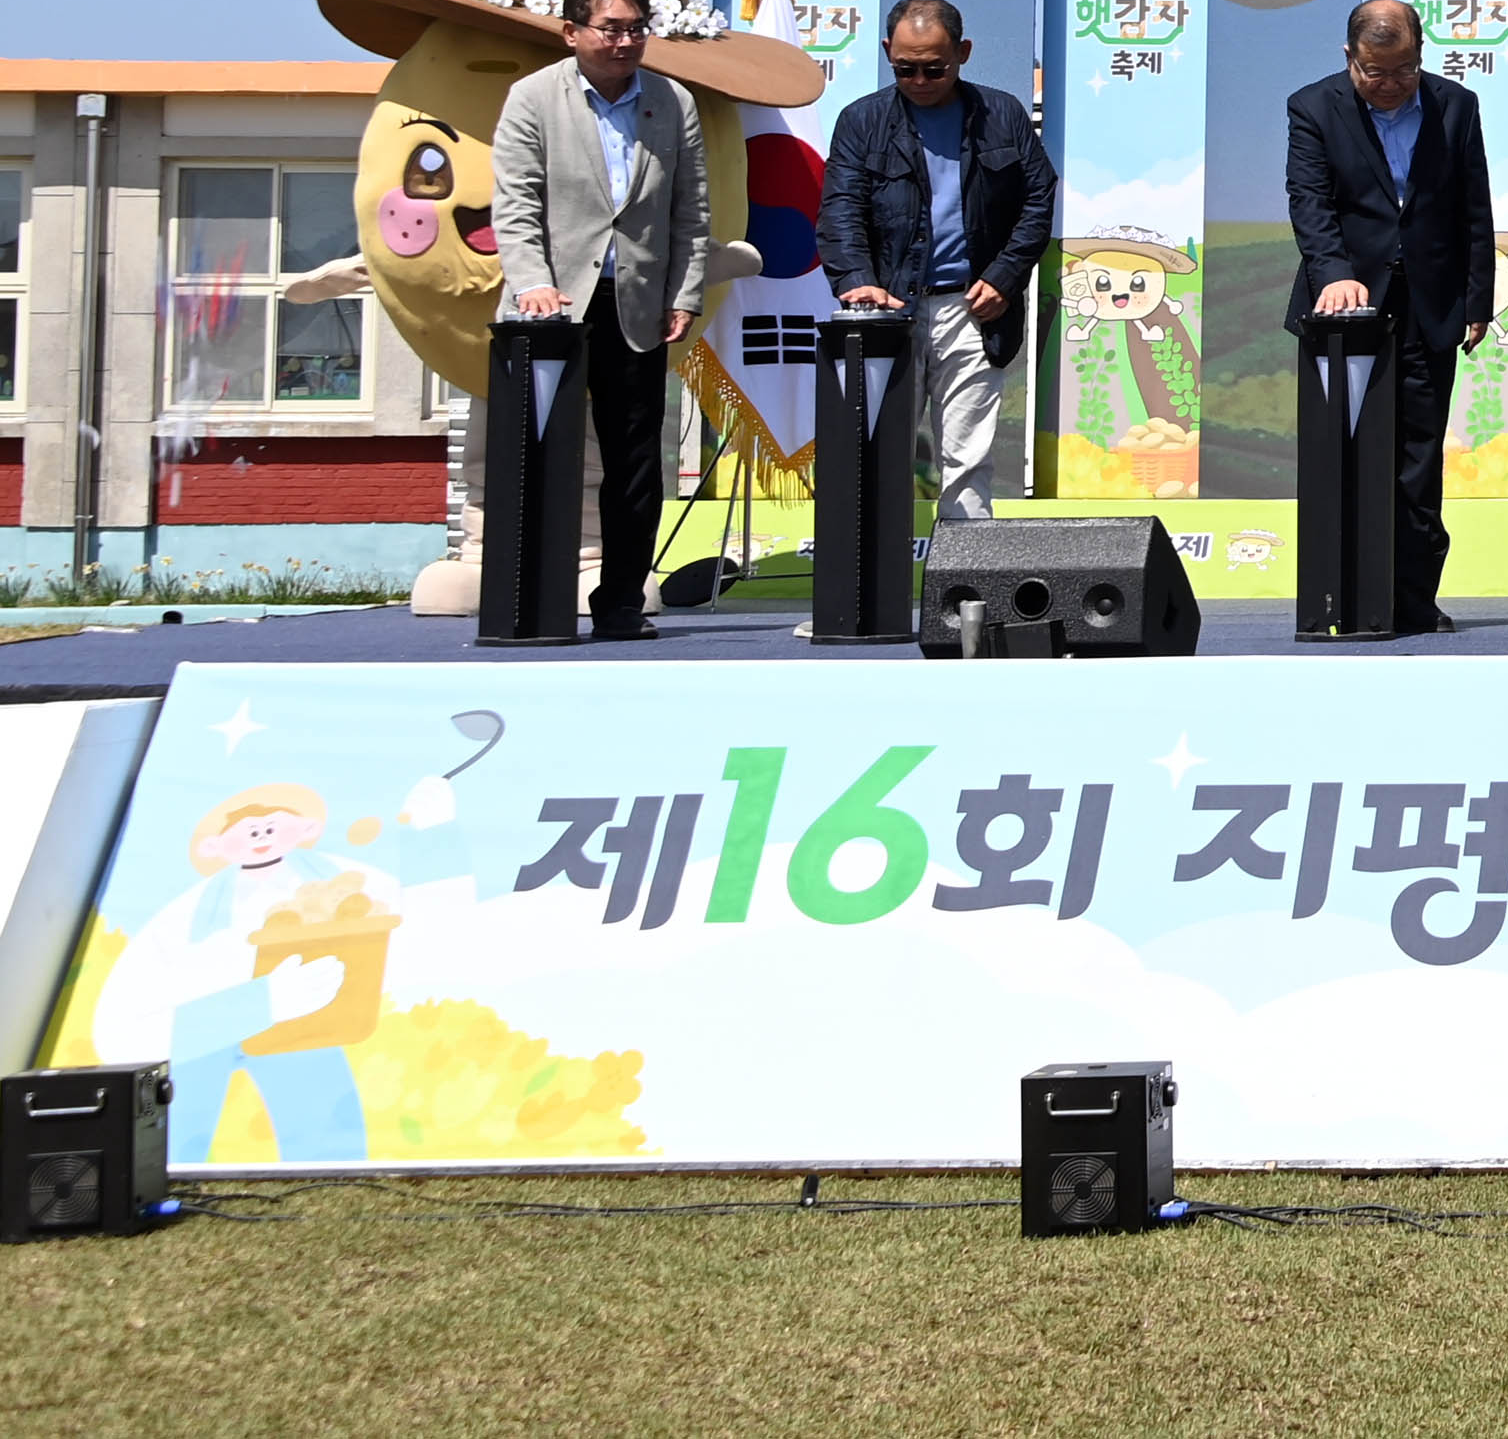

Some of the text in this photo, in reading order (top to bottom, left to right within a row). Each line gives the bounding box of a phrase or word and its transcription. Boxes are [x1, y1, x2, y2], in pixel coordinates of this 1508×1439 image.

[1110, 50, 1162, 81] 축제
[1442, 51, 1493, 82] 축제
[514, 745, 1113, 931] 제16회
